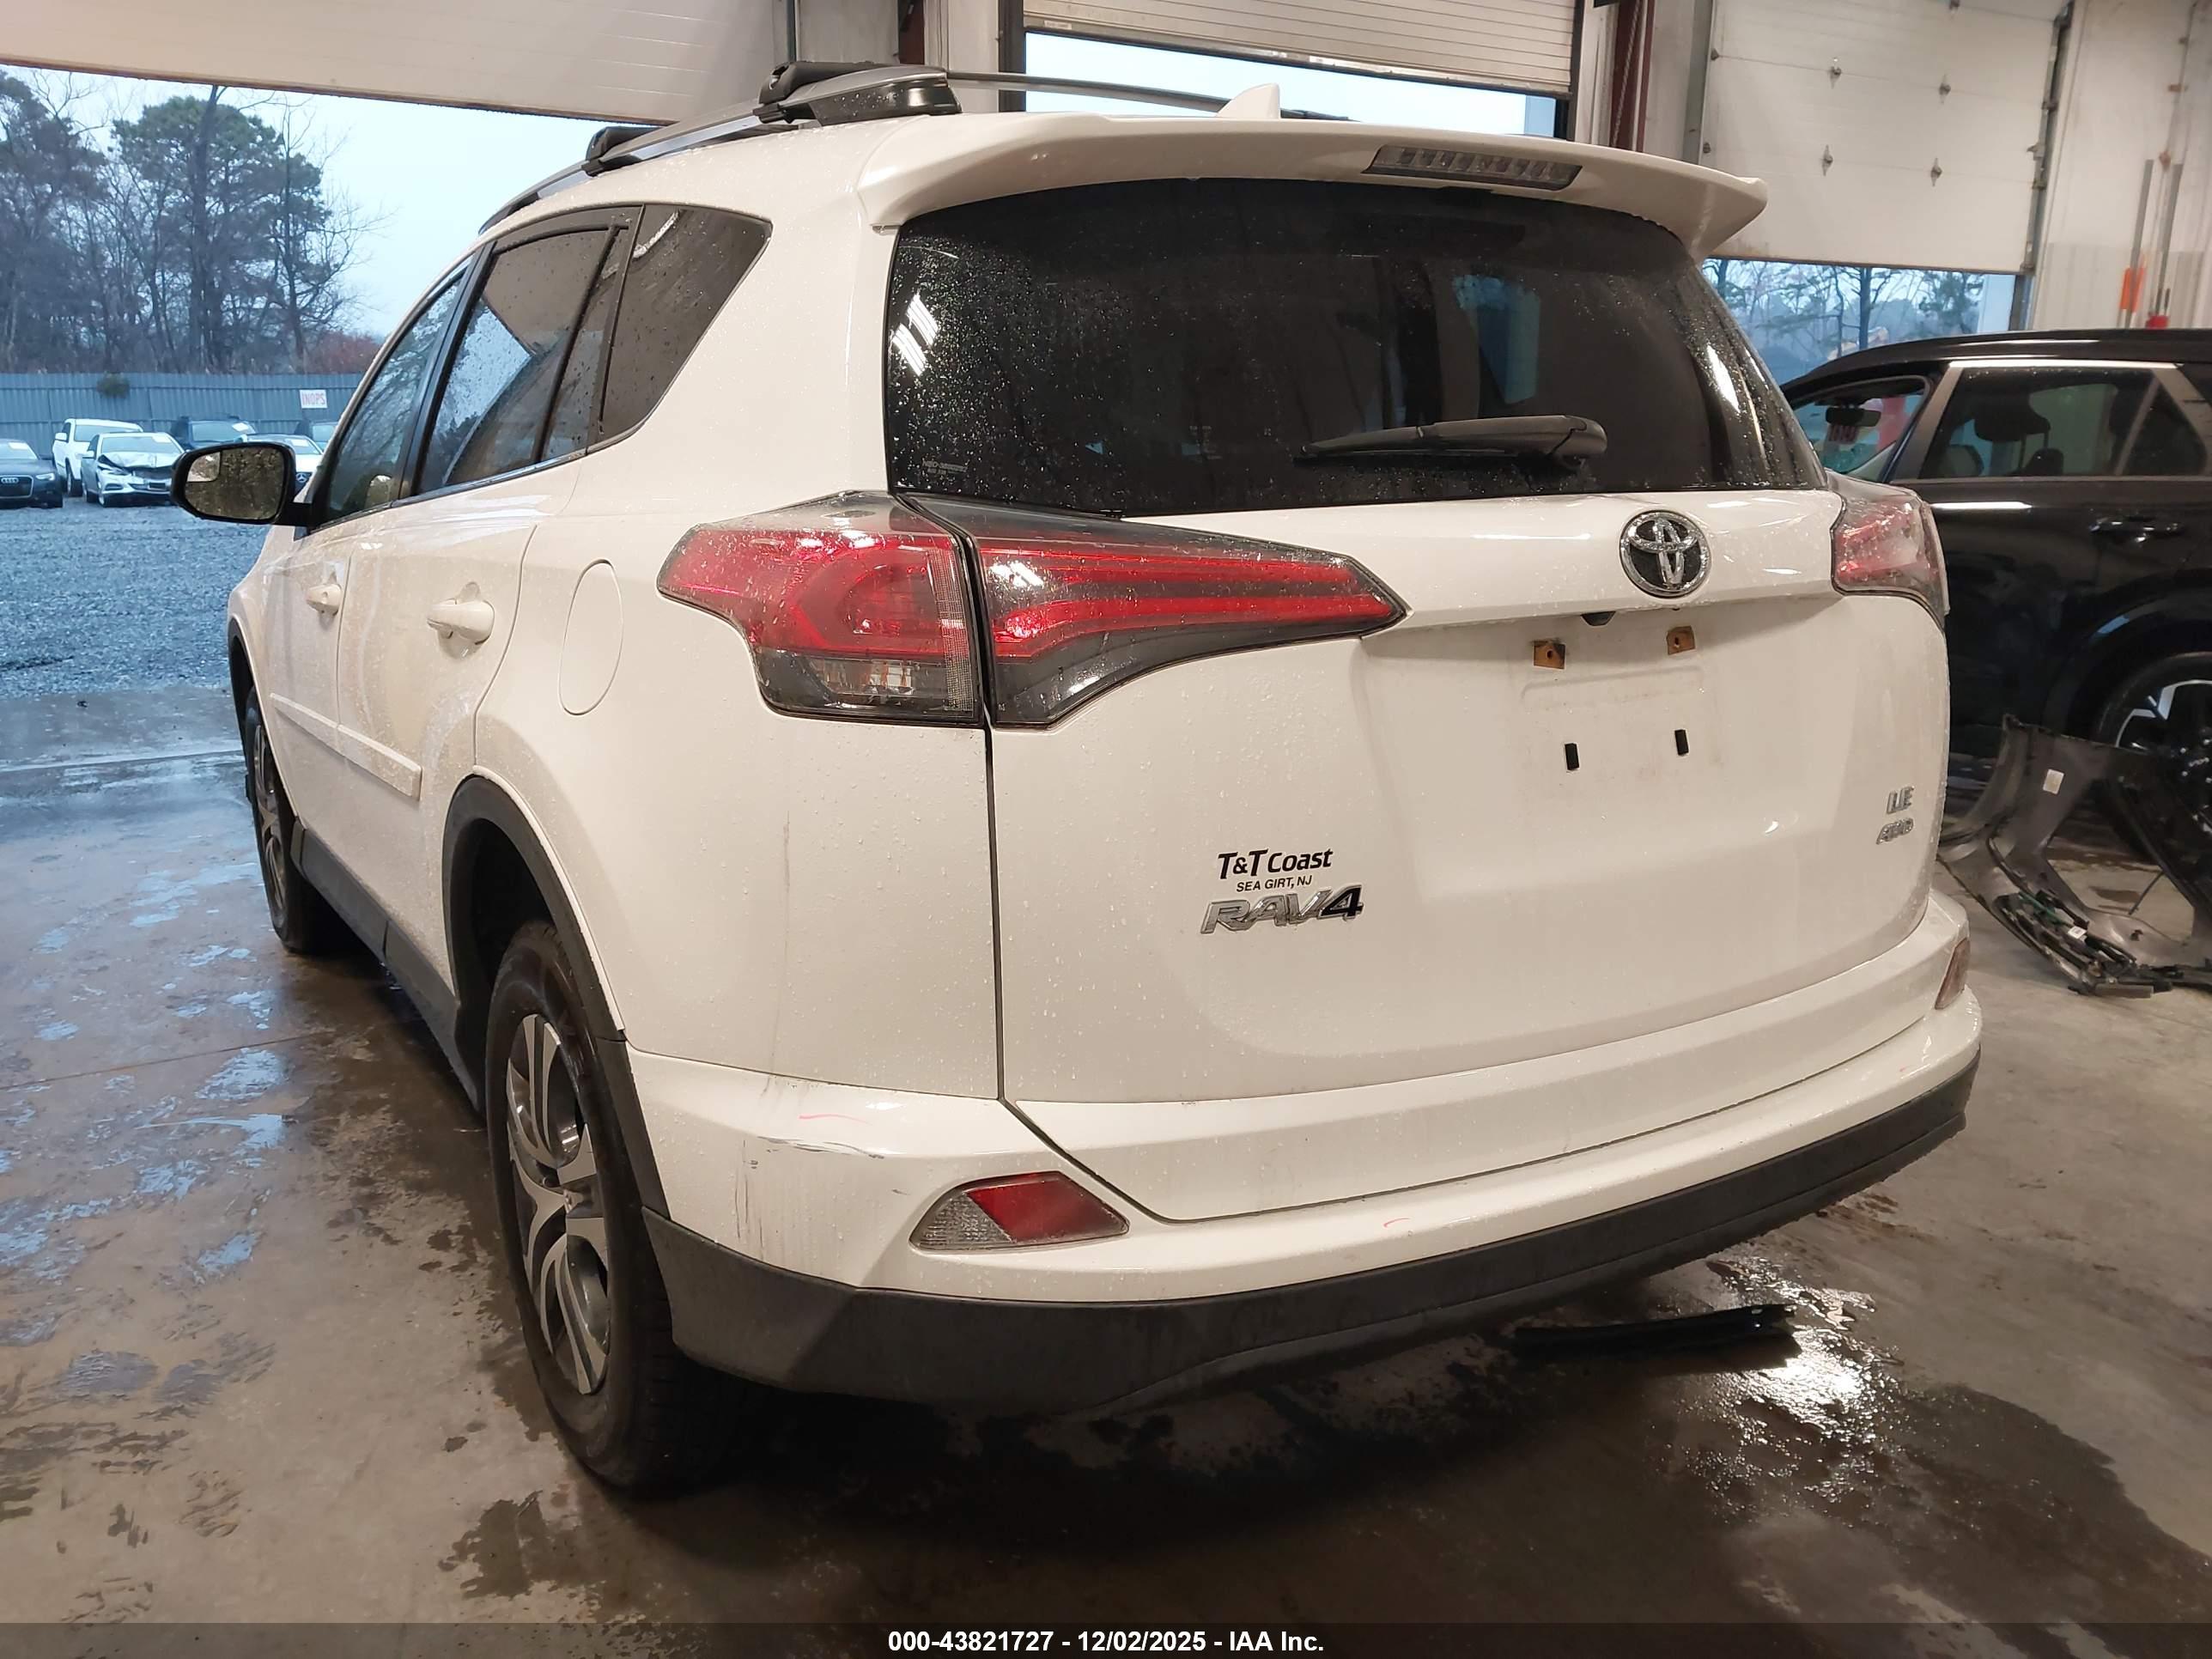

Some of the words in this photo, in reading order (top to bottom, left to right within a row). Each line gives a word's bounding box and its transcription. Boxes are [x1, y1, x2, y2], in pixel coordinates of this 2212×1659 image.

[301, 392, 325, 405] INOPS
[1887, 786, 1914, 814] LE
[1218, 848, 1268, 879] T&T
[1267, 848, 1333, 873] Coast
[1236, 881, 1261, 892] SEA
[1264, 878, 1294, 890] GIRT,
[1297, 875, 1312, 887] NJ
[1200, 884, 1364, 934] RAV4
